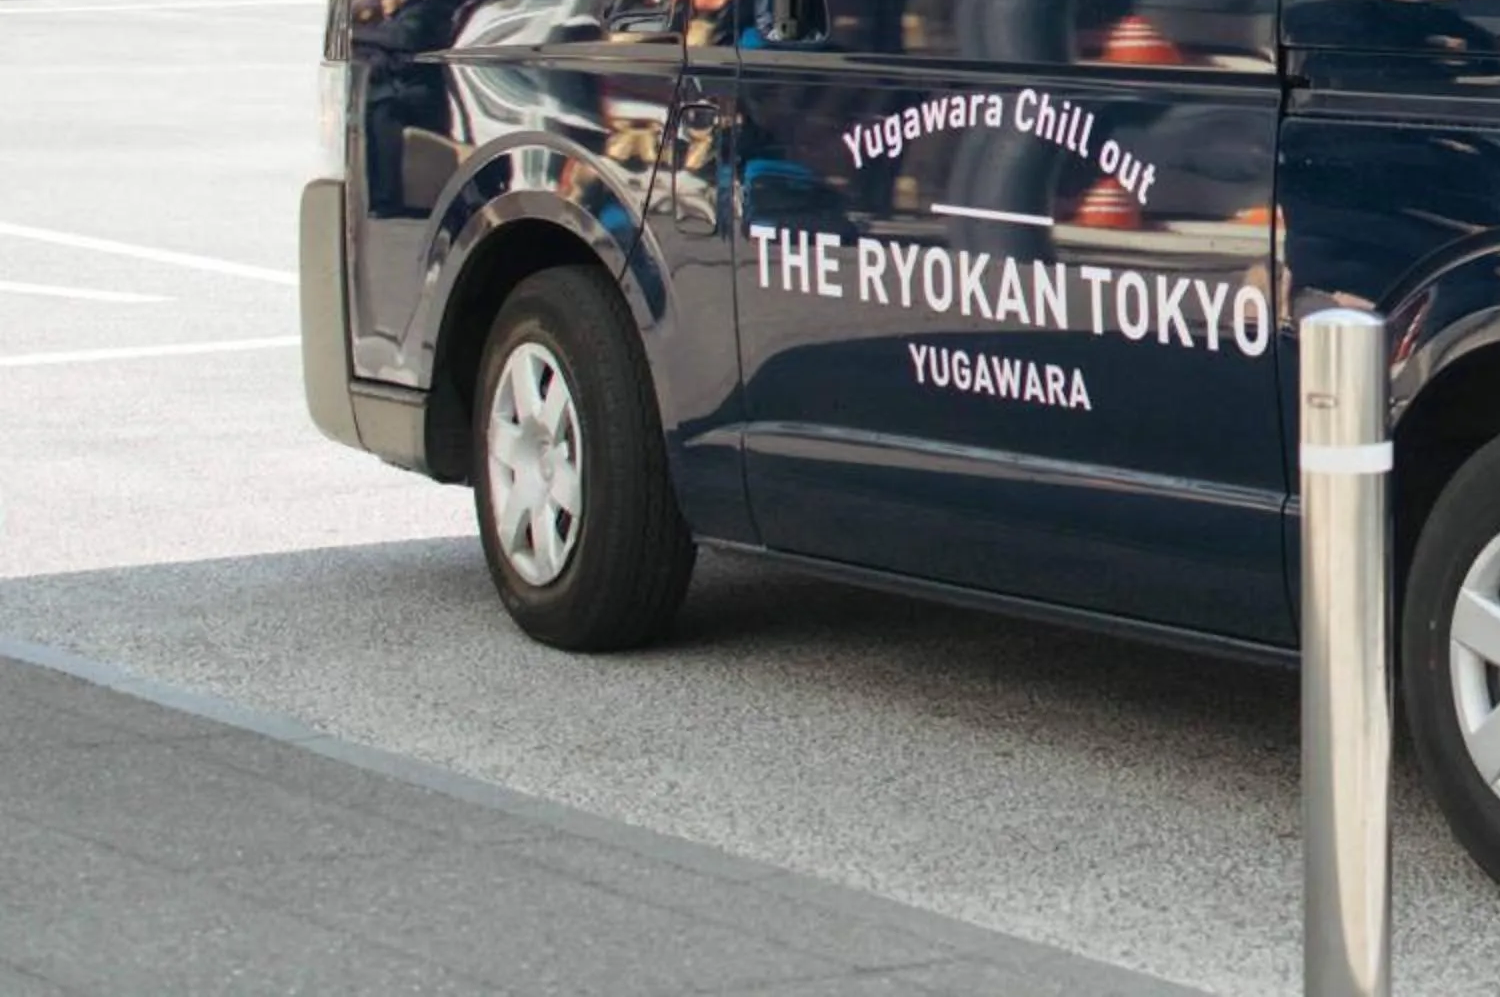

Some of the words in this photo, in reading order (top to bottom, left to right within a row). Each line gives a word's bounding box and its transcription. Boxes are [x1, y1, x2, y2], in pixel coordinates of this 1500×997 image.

[842, 92, 1003, 170] Yugawara
[1015, 88, 1093, 159] Chill
[1100, 140, 1157, 205] out
[750, 224, 844, 298] THE
[858, 238, 1069, 331] RYOKAN
[1080, 266, 1270, 358] TOKYO
[908, 342, 1092, 412] YUGAWARA
